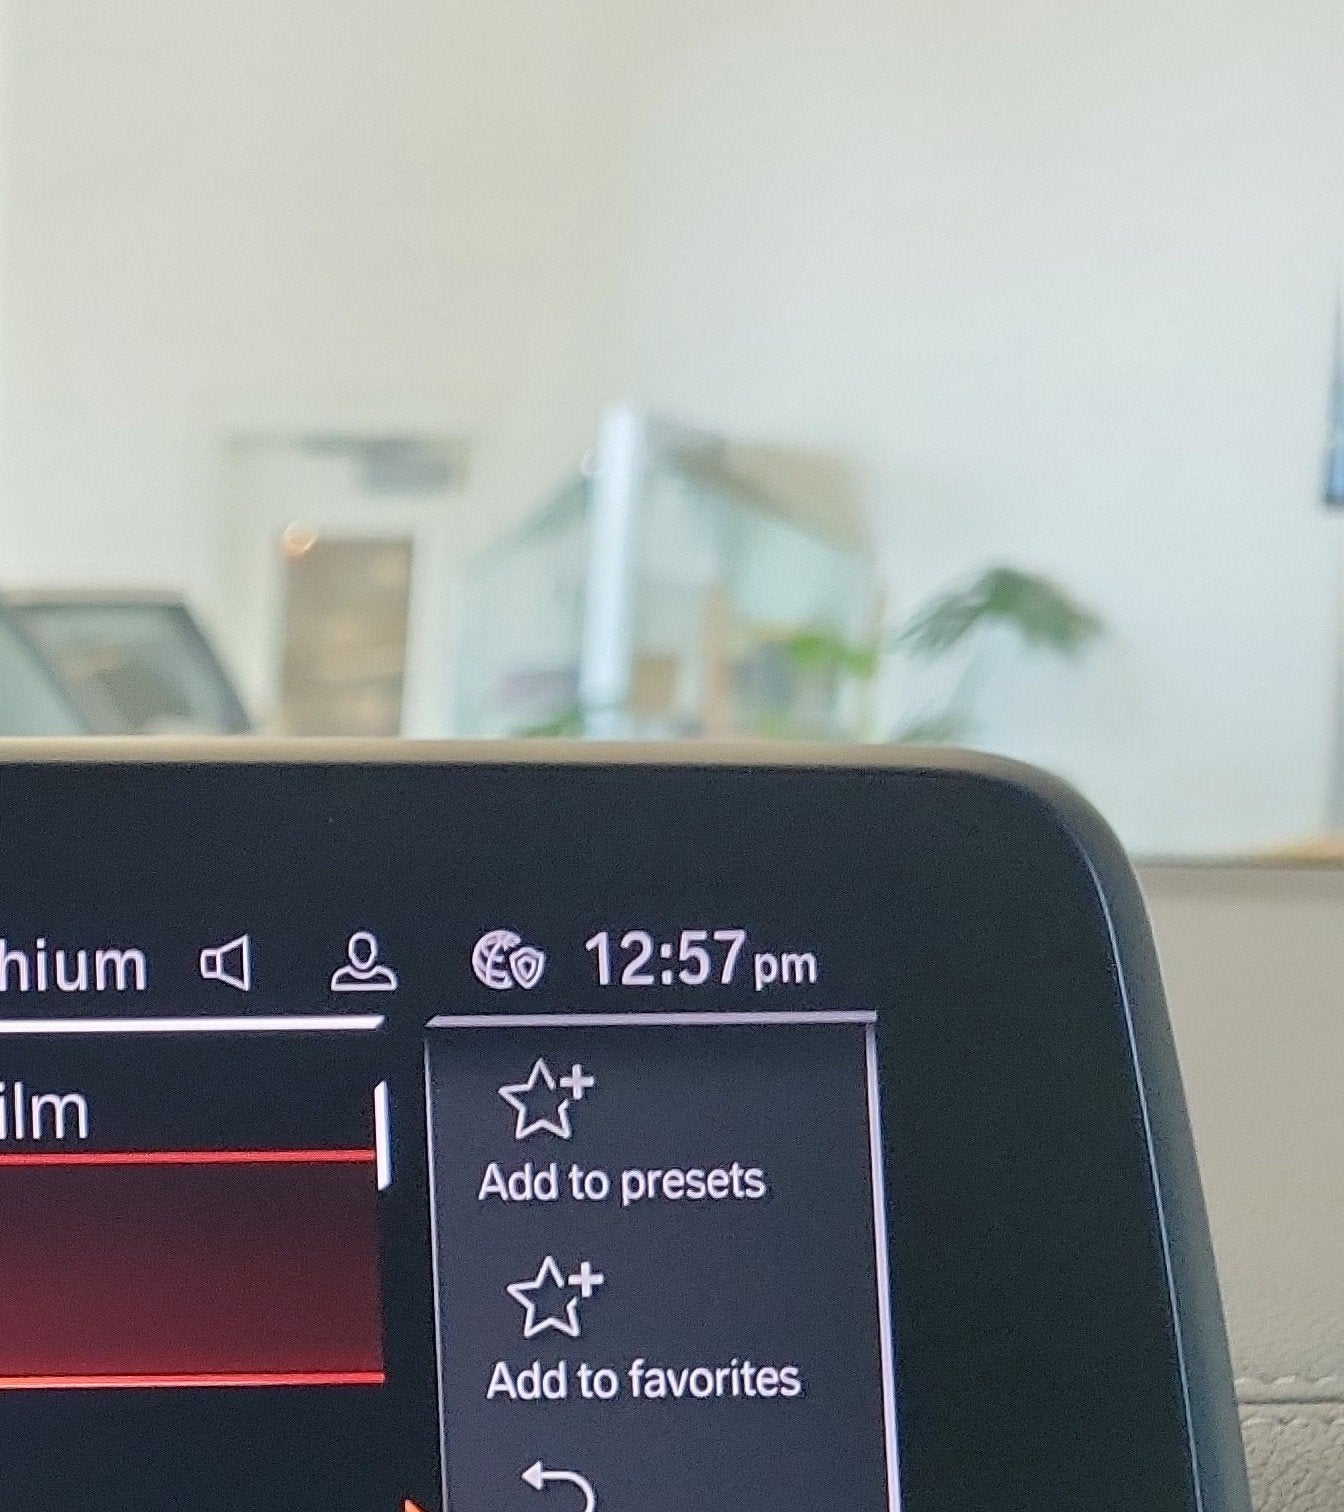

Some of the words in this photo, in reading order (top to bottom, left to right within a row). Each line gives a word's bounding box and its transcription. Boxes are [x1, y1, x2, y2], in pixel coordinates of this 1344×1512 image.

[477, 1161, 559, 1202] Add
[567, 1163, 611, 1201] to
[620, 1161, 767, 1208] presets
[485, 1359, 568, 1401] Add
[576, 1362, 621, 1400] to
[626, 1357, 802, 1399] favorites
